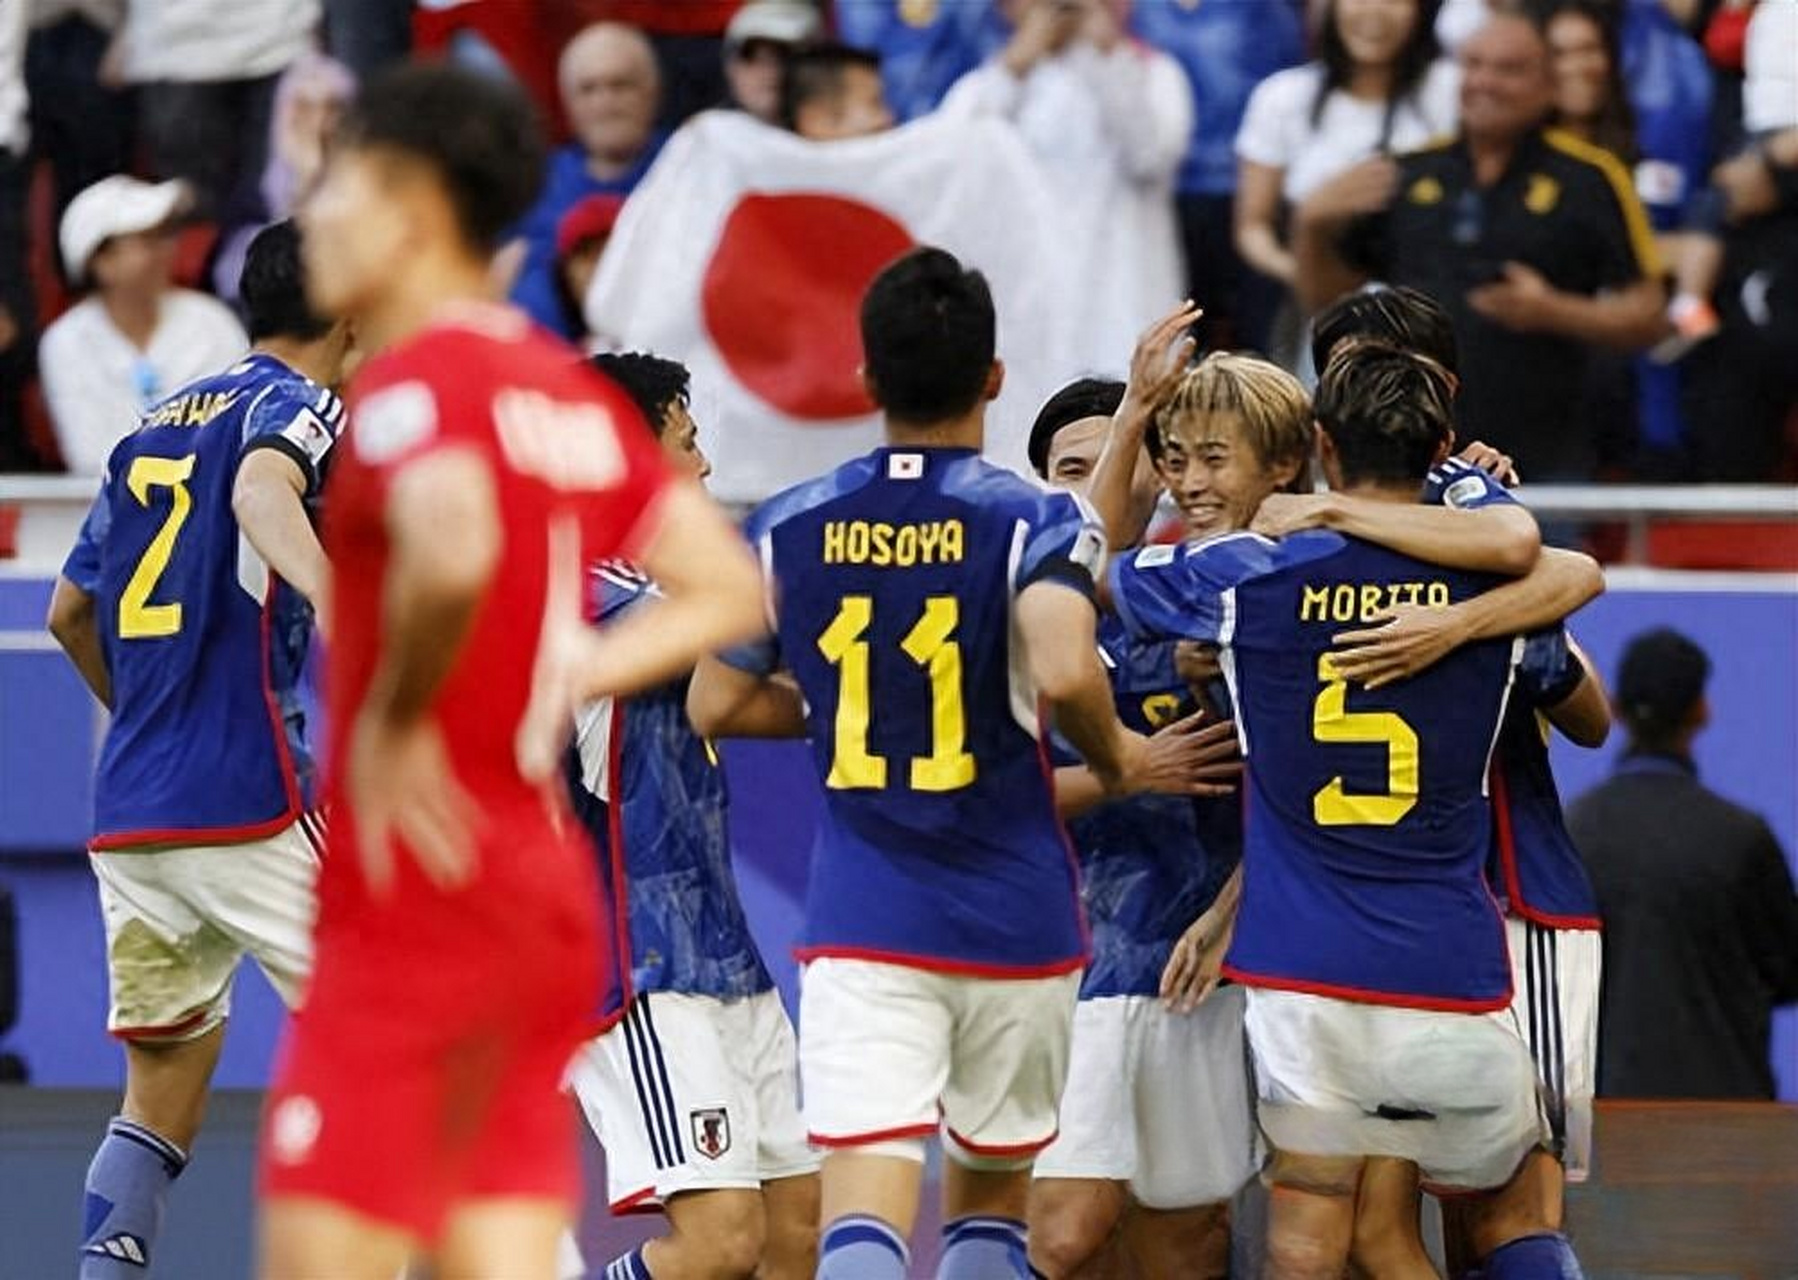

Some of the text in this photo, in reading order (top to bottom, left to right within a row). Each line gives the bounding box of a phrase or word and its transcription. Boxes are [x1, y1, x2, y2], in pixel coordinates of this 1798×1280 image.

[119, 455, 196, 639] 2
[823, 519, 964, 567] HOSOYA
[817, 597, 977, 791] 11
[1314, 652, 1419, 825] 5
